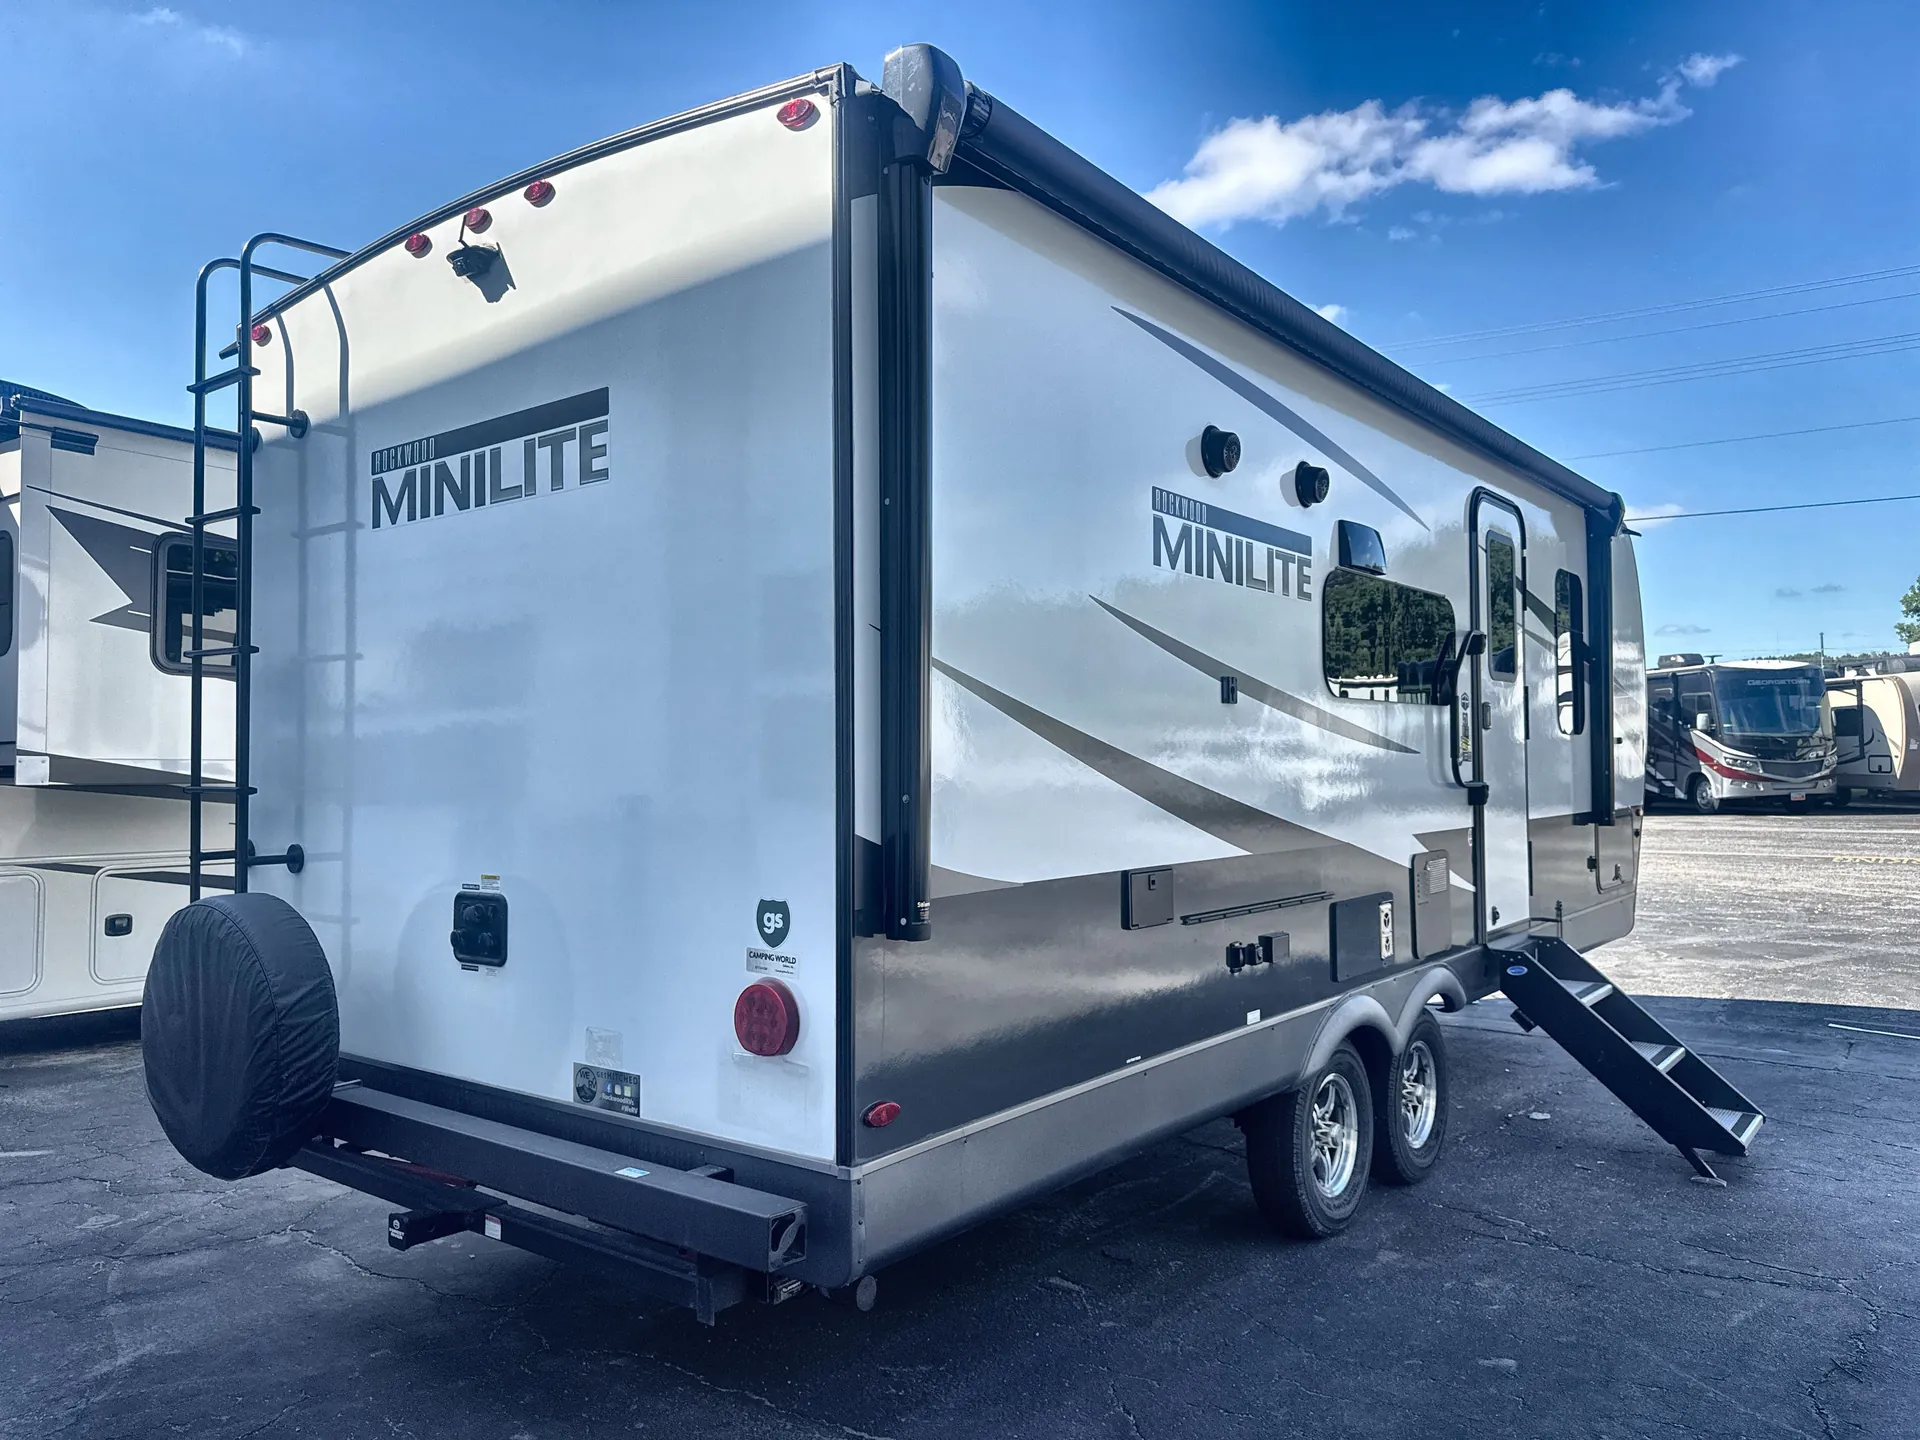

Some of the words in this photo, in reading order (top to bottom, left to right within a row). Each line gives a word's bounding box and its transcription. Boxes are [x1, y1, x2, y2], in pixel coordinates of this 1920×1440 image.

[375, 437, 435, 473] ROCKWOOD
[372, 418, 609, 529] MINILITE
[1155, 489, 1207, 524] ROCKWOOD
[1153, 513, 1312, 602] MINILITE
[763, 912, 783, 934] gs
[749, 951, 775, 962] CAMPING
[775, 955, 797, 965] WORLD
[580, 1070, 591, 1079] WE
